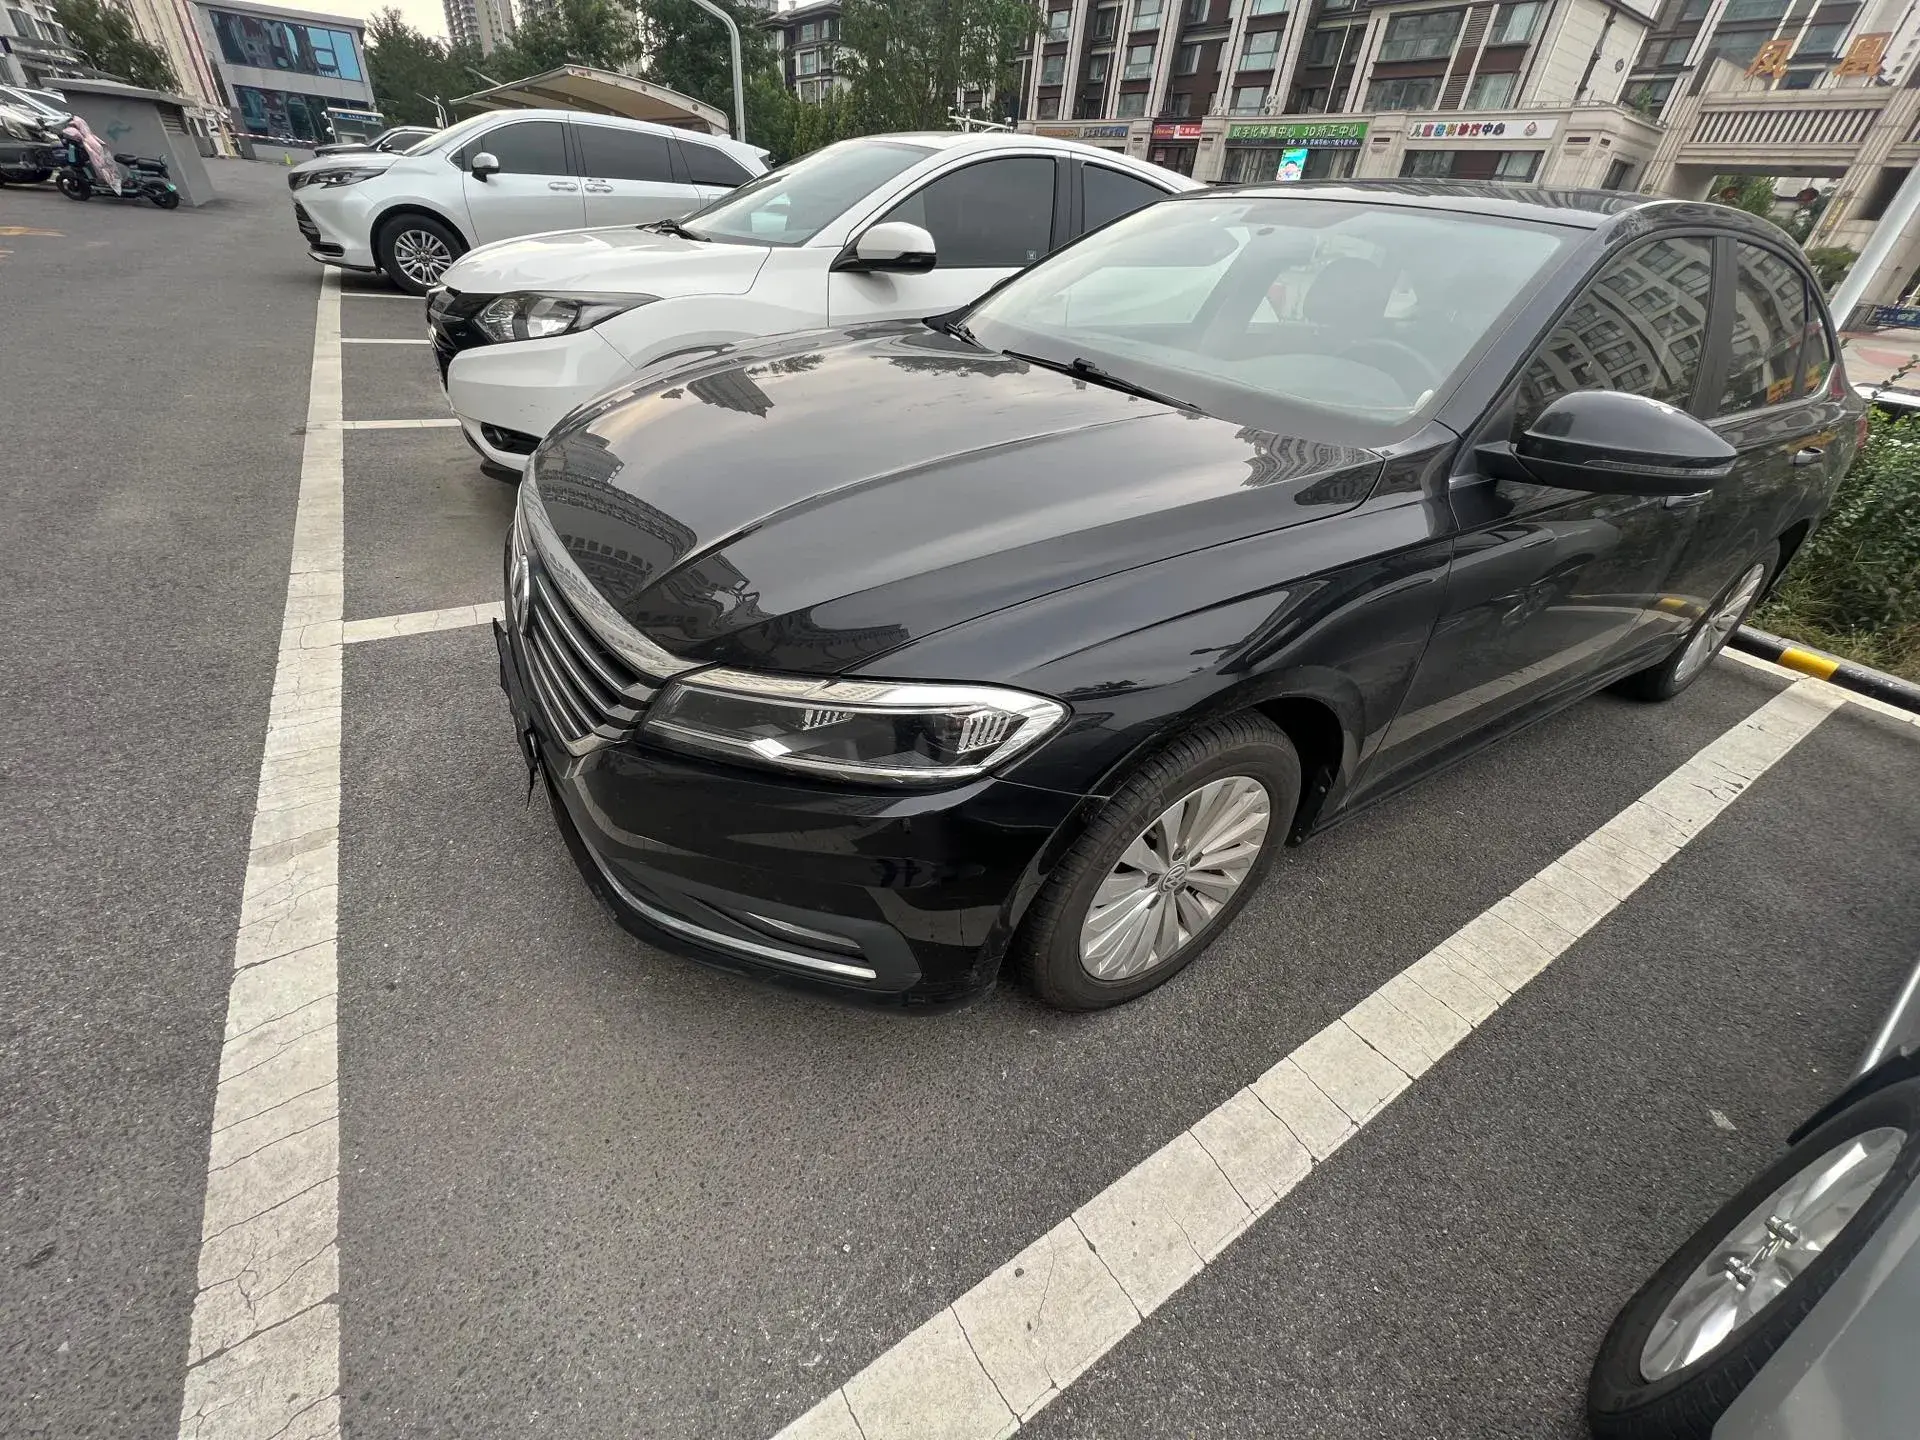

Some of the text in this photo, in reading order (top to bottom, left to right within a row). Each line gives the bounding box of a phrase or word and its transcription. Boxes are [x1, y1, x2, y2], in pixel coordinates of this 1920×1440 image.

[1232, 124, 1359, 138] 数字化种植中心 3D矫正中心
